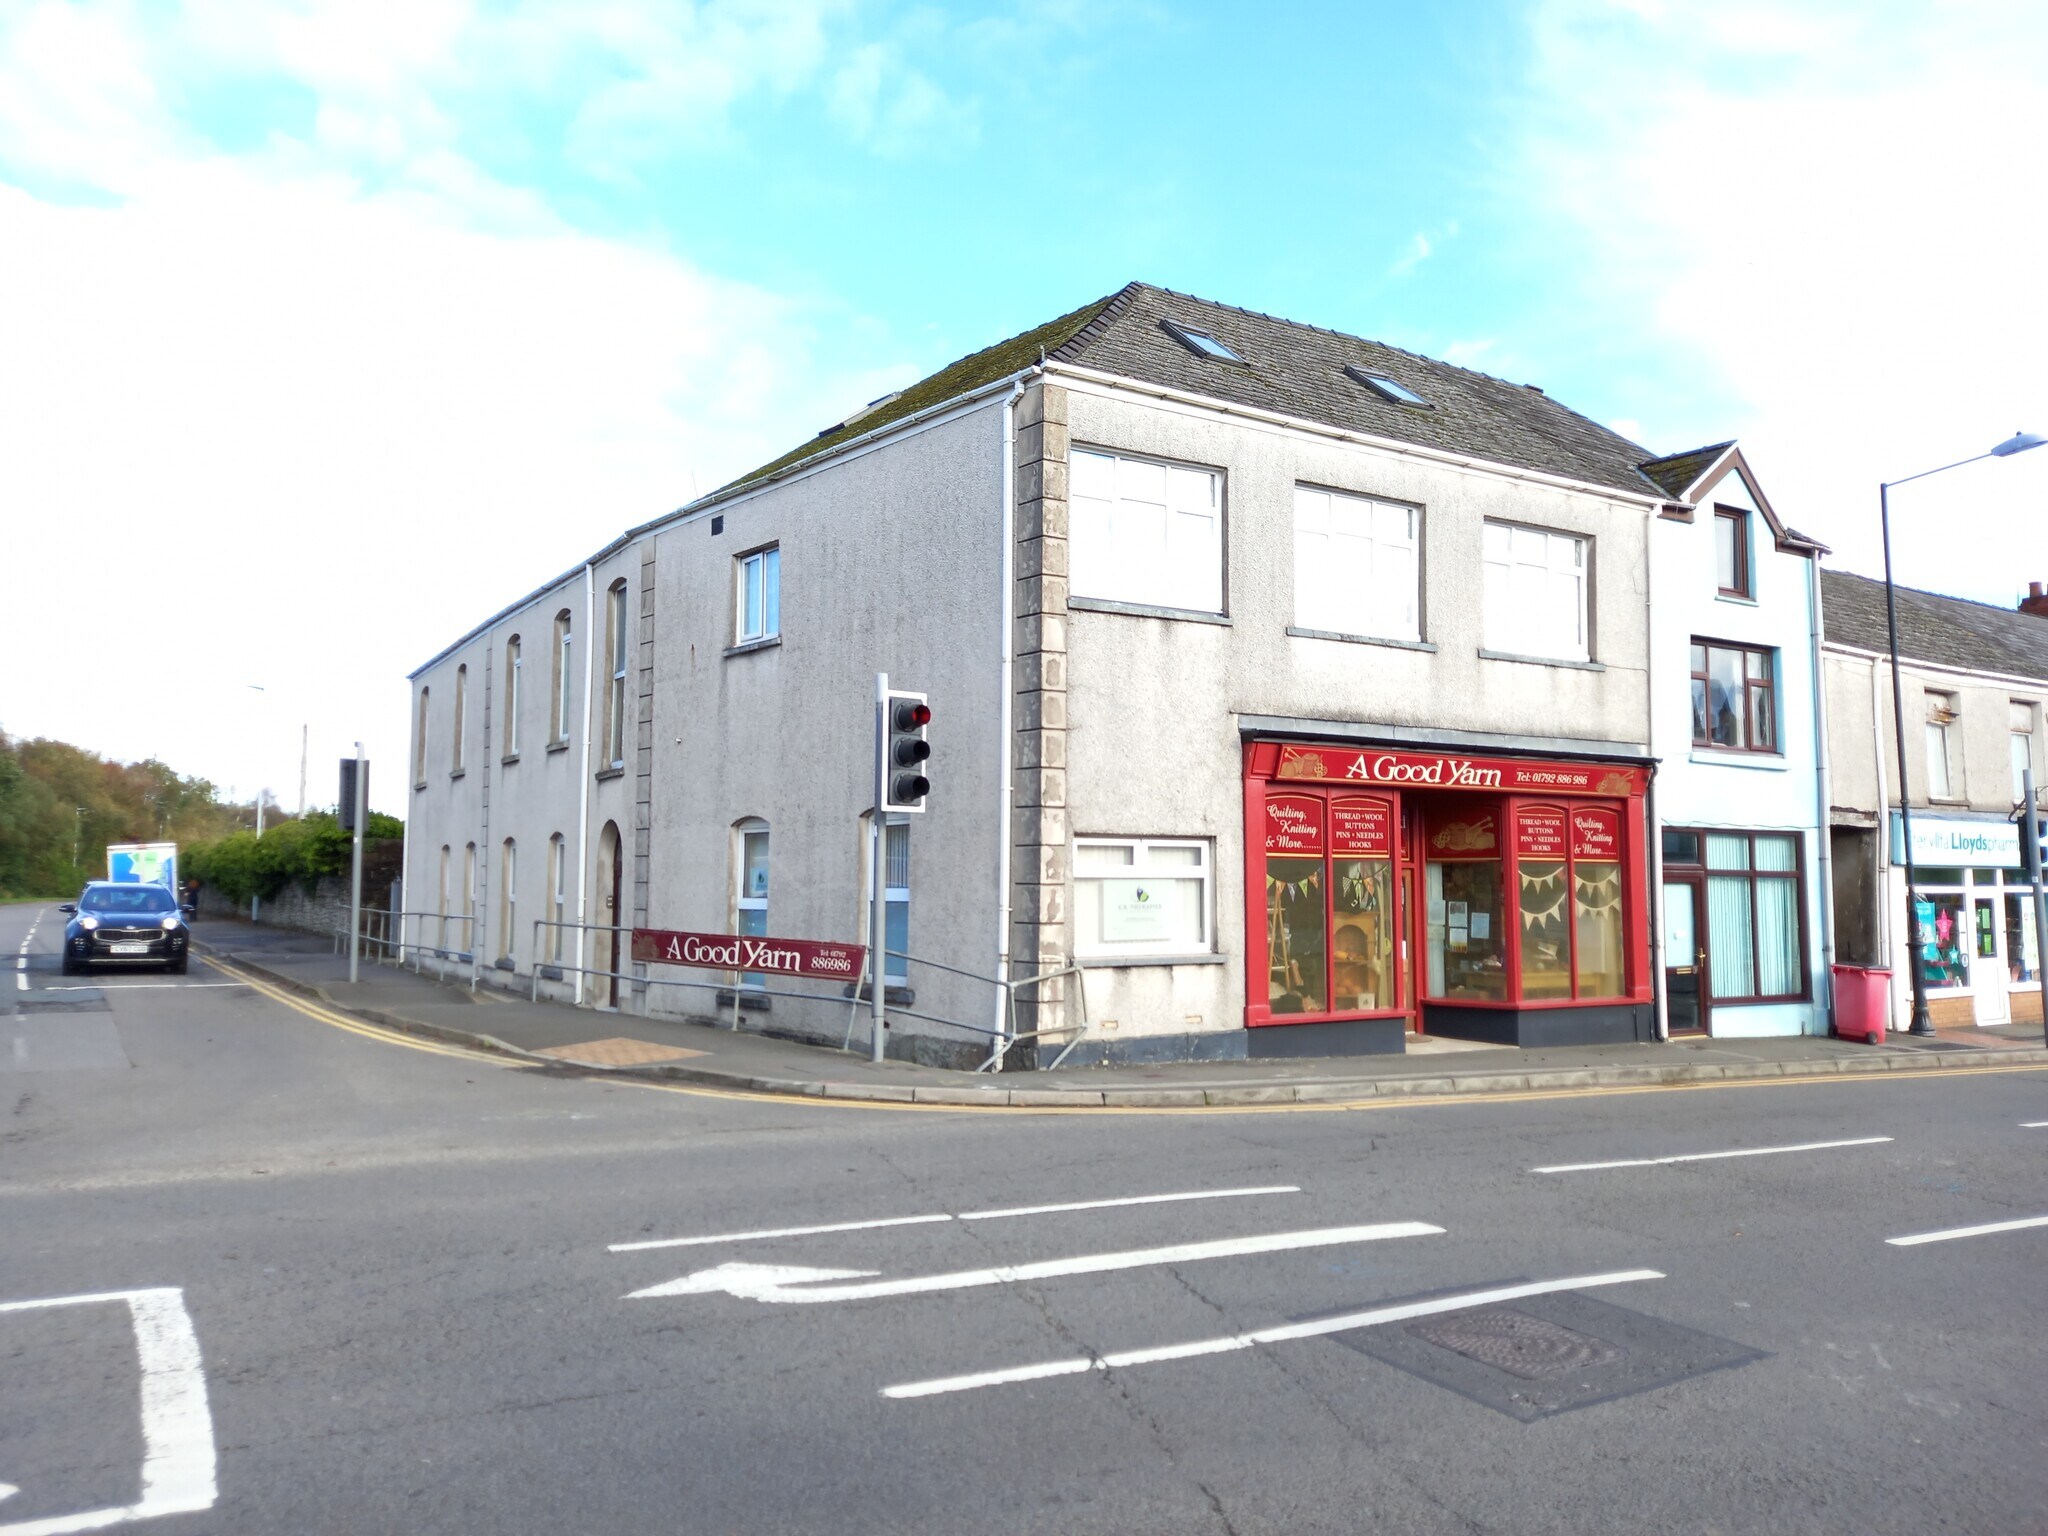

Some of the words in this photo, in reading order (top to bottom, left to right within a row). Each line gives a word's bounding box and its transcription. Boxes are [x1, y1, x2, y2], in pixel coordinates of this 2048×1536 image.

[1346, 754, 1370, 779] A
[1374, 756, 1442, 783] Good
[1445, 760, 1501, 787] Yarn
[1516, 772, 1531, 782] Tel:
[1532, 773, 1556, 783] 01792
[1557, 774, 1572, 784] 886
[1573, 775, 1588, 785] 986
[1267, 804, 1307, 822] Quilting,
[1334, 812, 1361, 820] THREAD
[1365, 813, 1384, 821] WOOL
[1280, 820, 1318, 838] Knitting
[1344, 822, 1375, 830] BUTTONS
[1520, 818, 1541, 826] THREAD
[1265, 835, 1275, 848] &
[1336, 831, 1351, 839] PINS
[1584, 830, 1613, 846] Knitting
[1574, 844, 1581, 855] &
[1951, 832, 2019, 855] Lloydspharm
[667, 936, 682, 960] A
[684, 937, 740, 965] Good
[743, 940, 801, 971] Yarn
[811, 956, 851, 972] 886986
